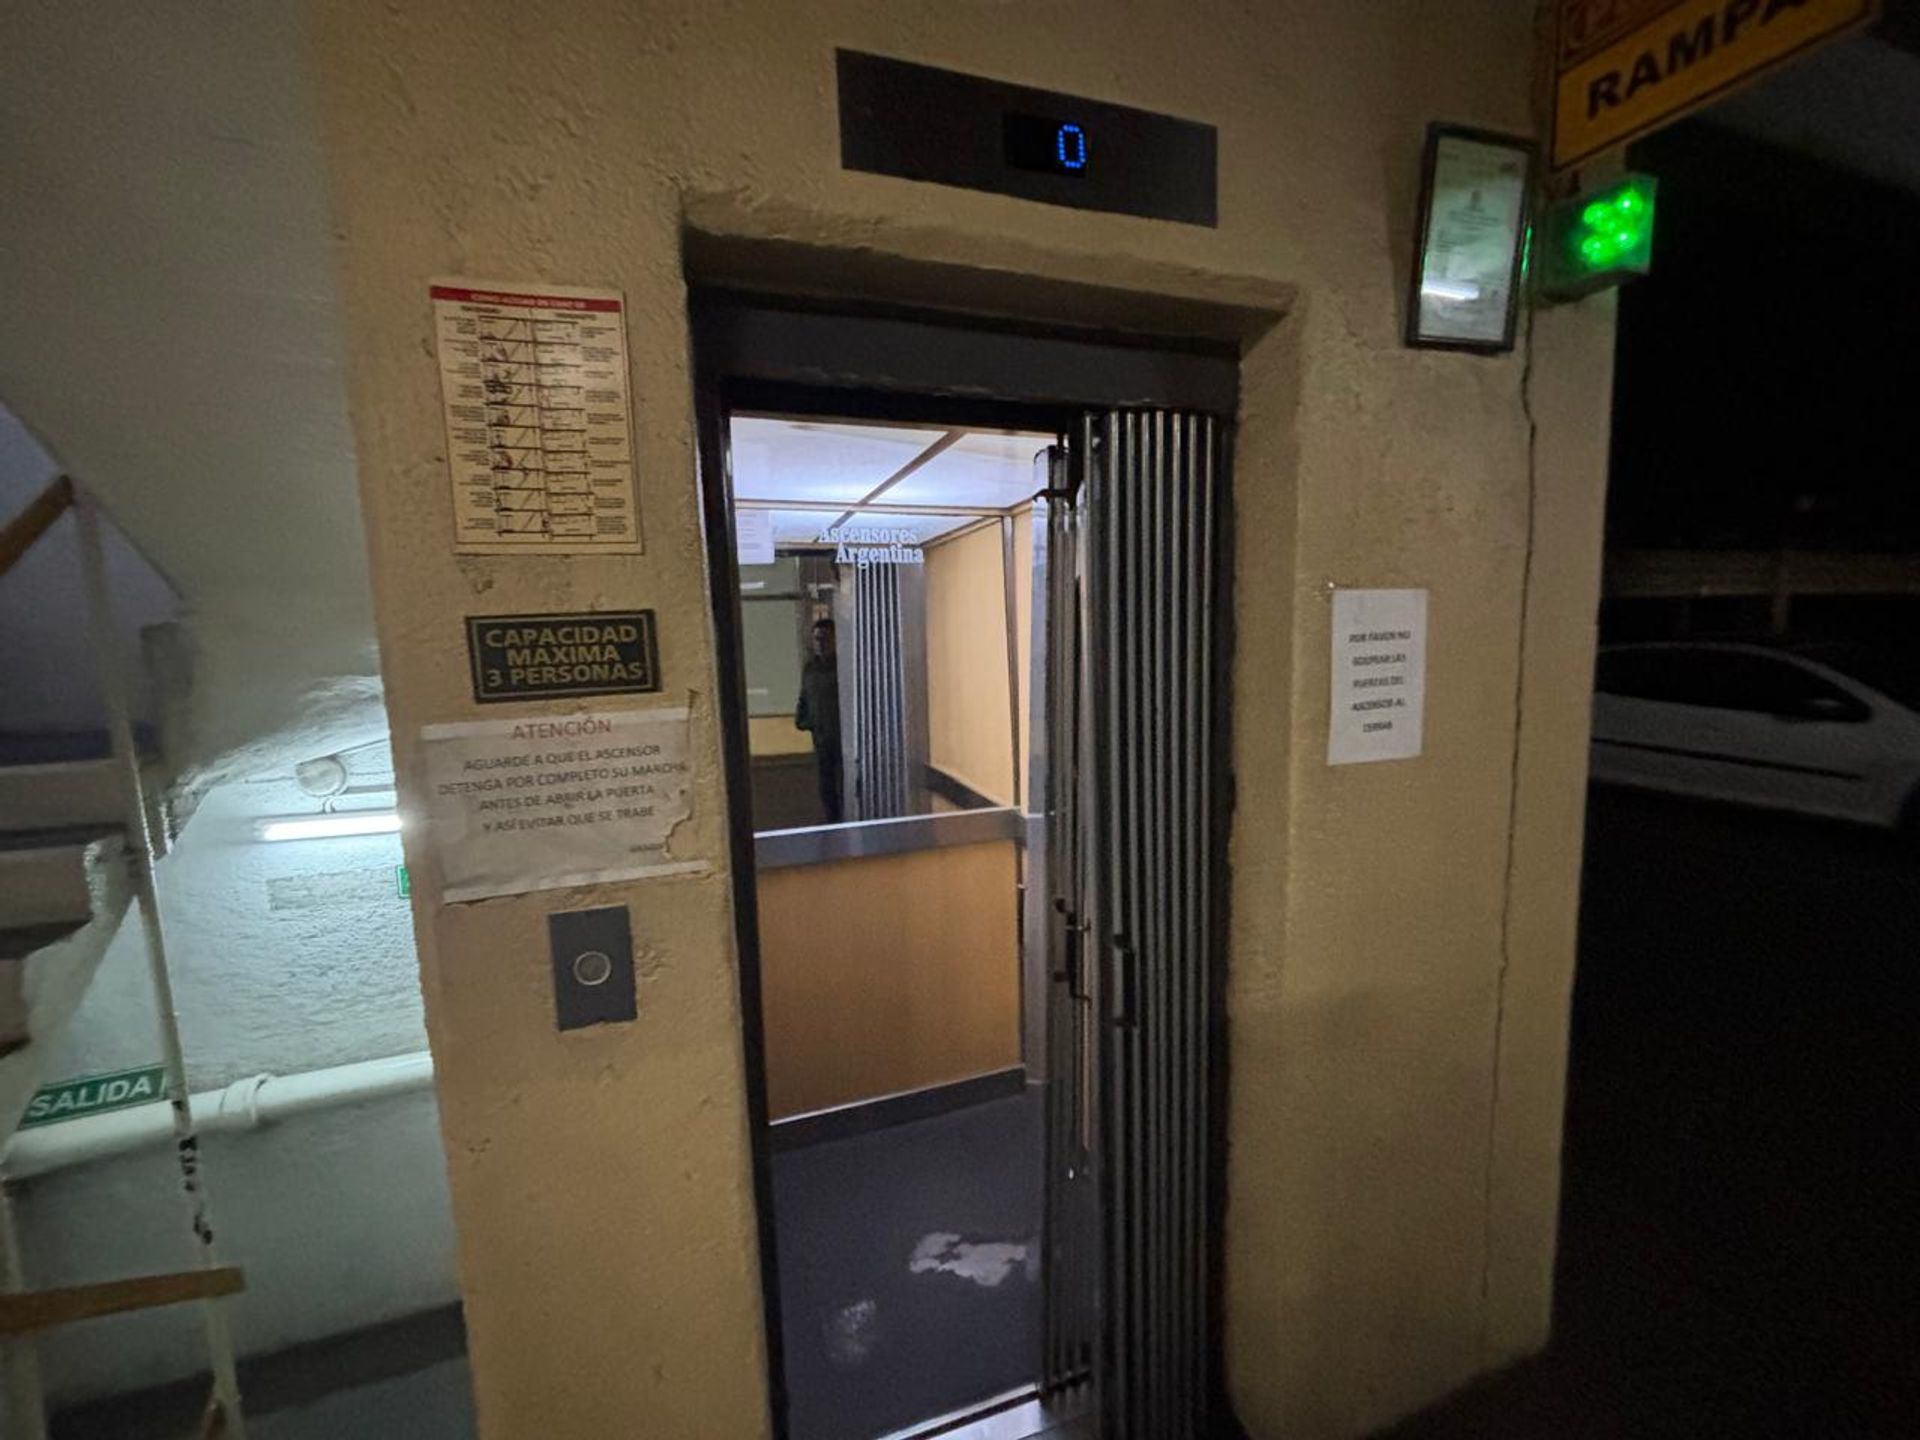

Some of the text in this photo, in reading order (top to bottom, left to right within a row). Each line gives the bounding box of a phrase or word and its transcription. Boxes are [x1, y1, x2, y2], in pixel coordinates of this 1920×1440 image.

[1057, 123, 1086, 169] 0
[817, 527, 918, 544] Ascensores
[834, 542, 925, 569] Argentina
[485, 625, 637, 648] CAPACIDAD
[487, 661, 643, 687] 3 PERSONAS
[513, 717, 611, 739] ATENCIÓN
[546, 751, 574, 765] QUE
[577, 750, 591, 761] EL
[596, 745, 660, 760] ASCENSOR
[438, 778, 502, 795] DETENGA
[506, 775, 534, 788] POR
[537, 768, 609, 786] COMPLETO
[612, 766, 629, 778] SU
[524, 795, 541, 808] DE
[606, 785, 655, 799] PUERTA
[567, 812, 595, 826] QUE
[616, 805, 655, 819] TRABE
[29, 1075, 152, 1117] SALIDA
